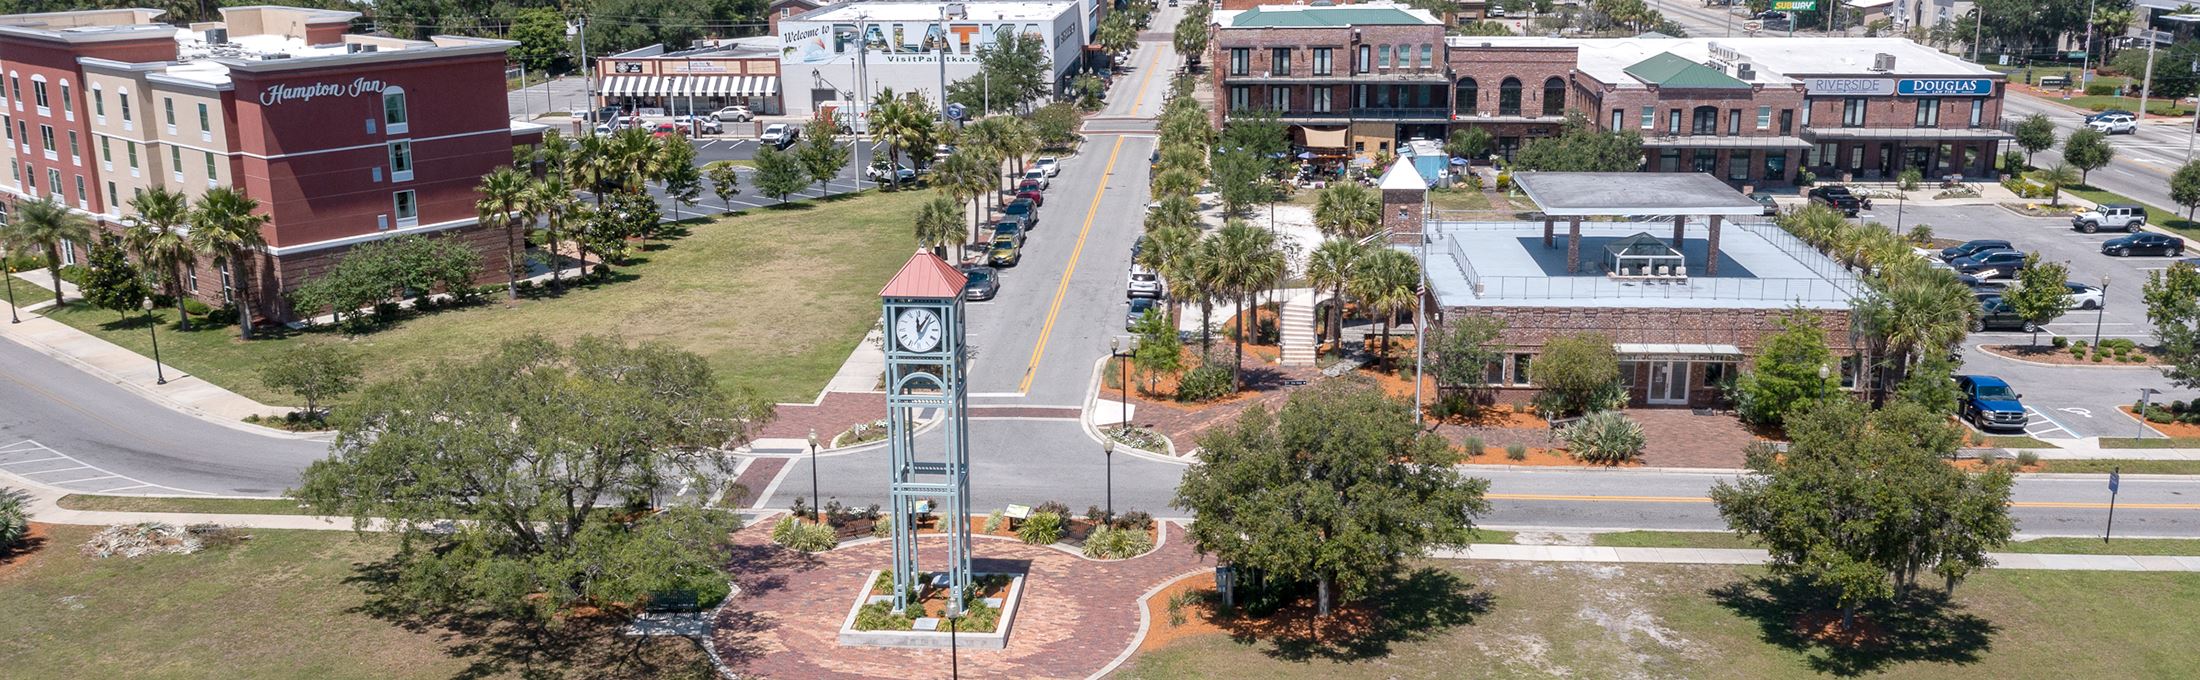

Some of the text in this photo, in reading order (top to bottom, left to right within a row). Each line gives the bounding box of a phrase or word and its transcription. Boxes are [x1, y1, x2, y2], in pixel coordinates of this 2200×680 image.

[1774, 1, 1815, 10] SUBWAY
[784, 24, 830, 43] Welcome to
[1816, 79, 1880, 91] RIVERSIDE
[1913, 80, 1977, 91] DOUGLAS
[260, 77, 387, 106] Hampton Inn
